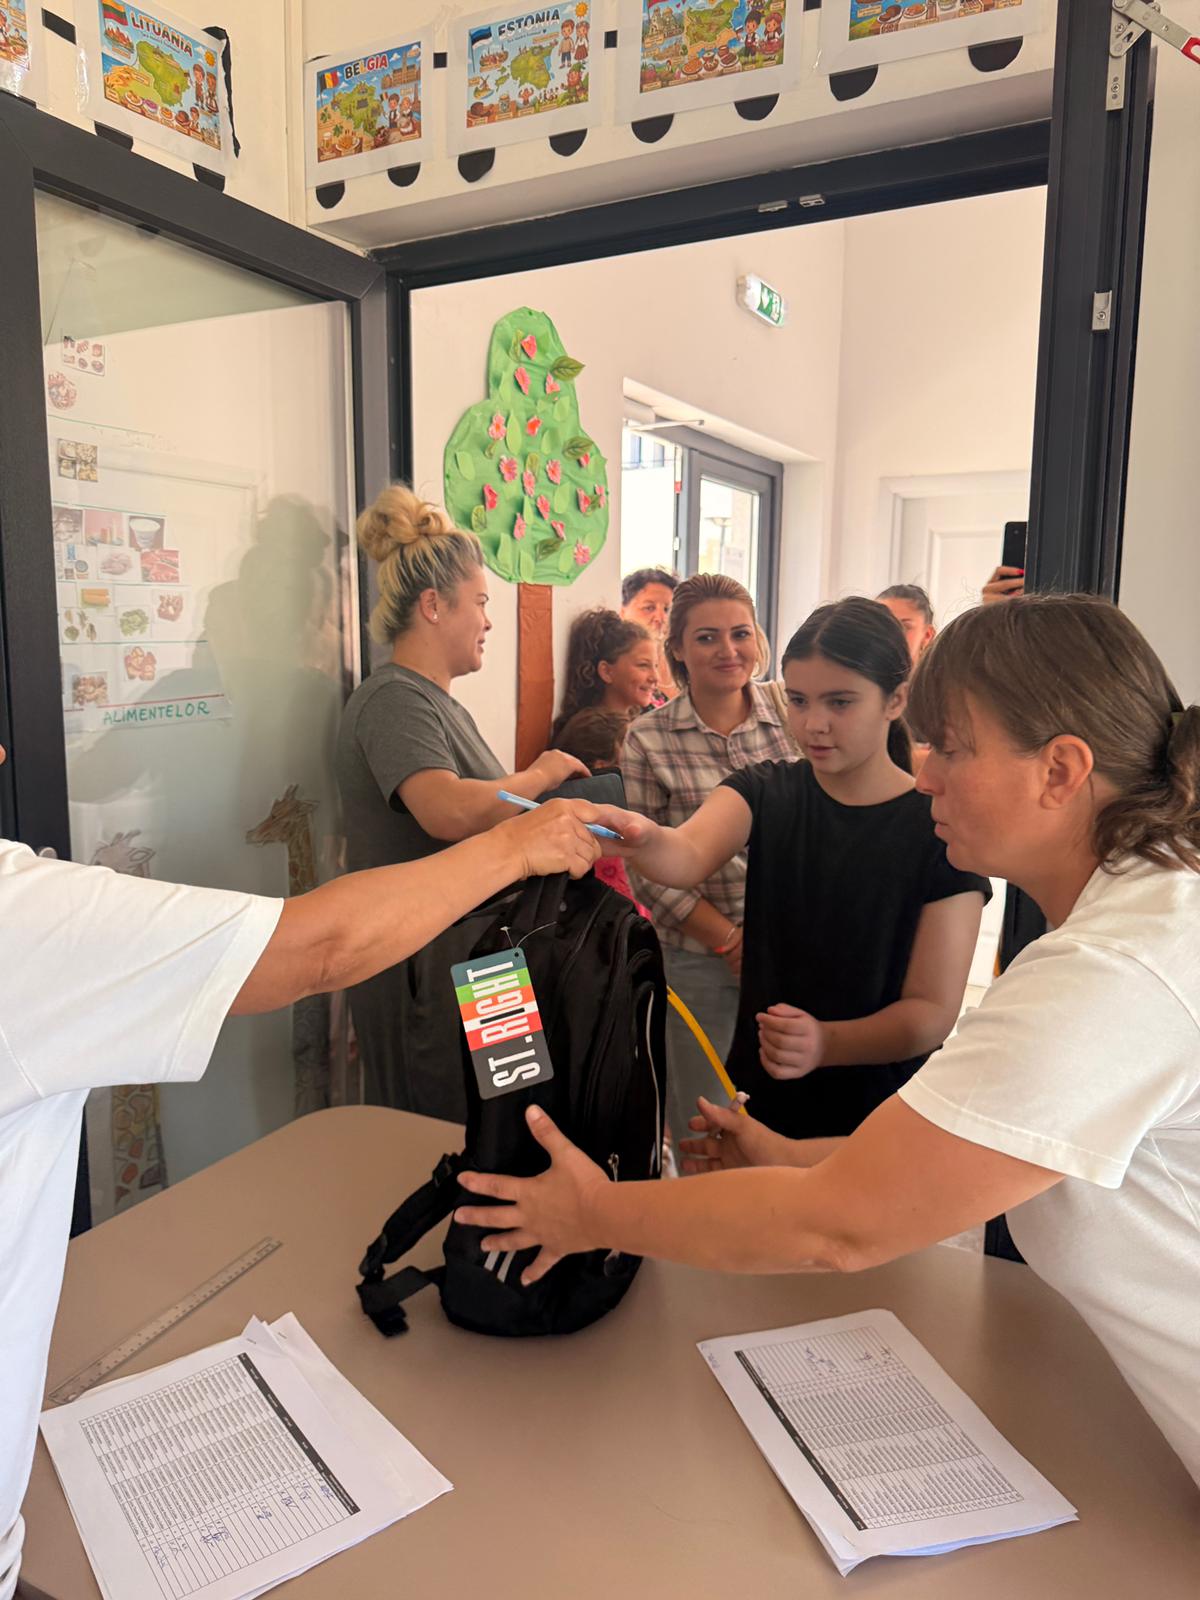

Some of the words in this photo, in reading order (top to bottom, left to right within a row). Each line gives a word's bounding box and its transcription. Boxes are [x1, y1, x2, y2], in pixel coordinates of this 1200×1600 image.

[130, 11, 193, 57] LITUANIA
[497, 8, 561, 41] ESTONIA
[344, 53, 389, 79] BELGIA
[466, 960, 541, 1089] ST.RIGHT
